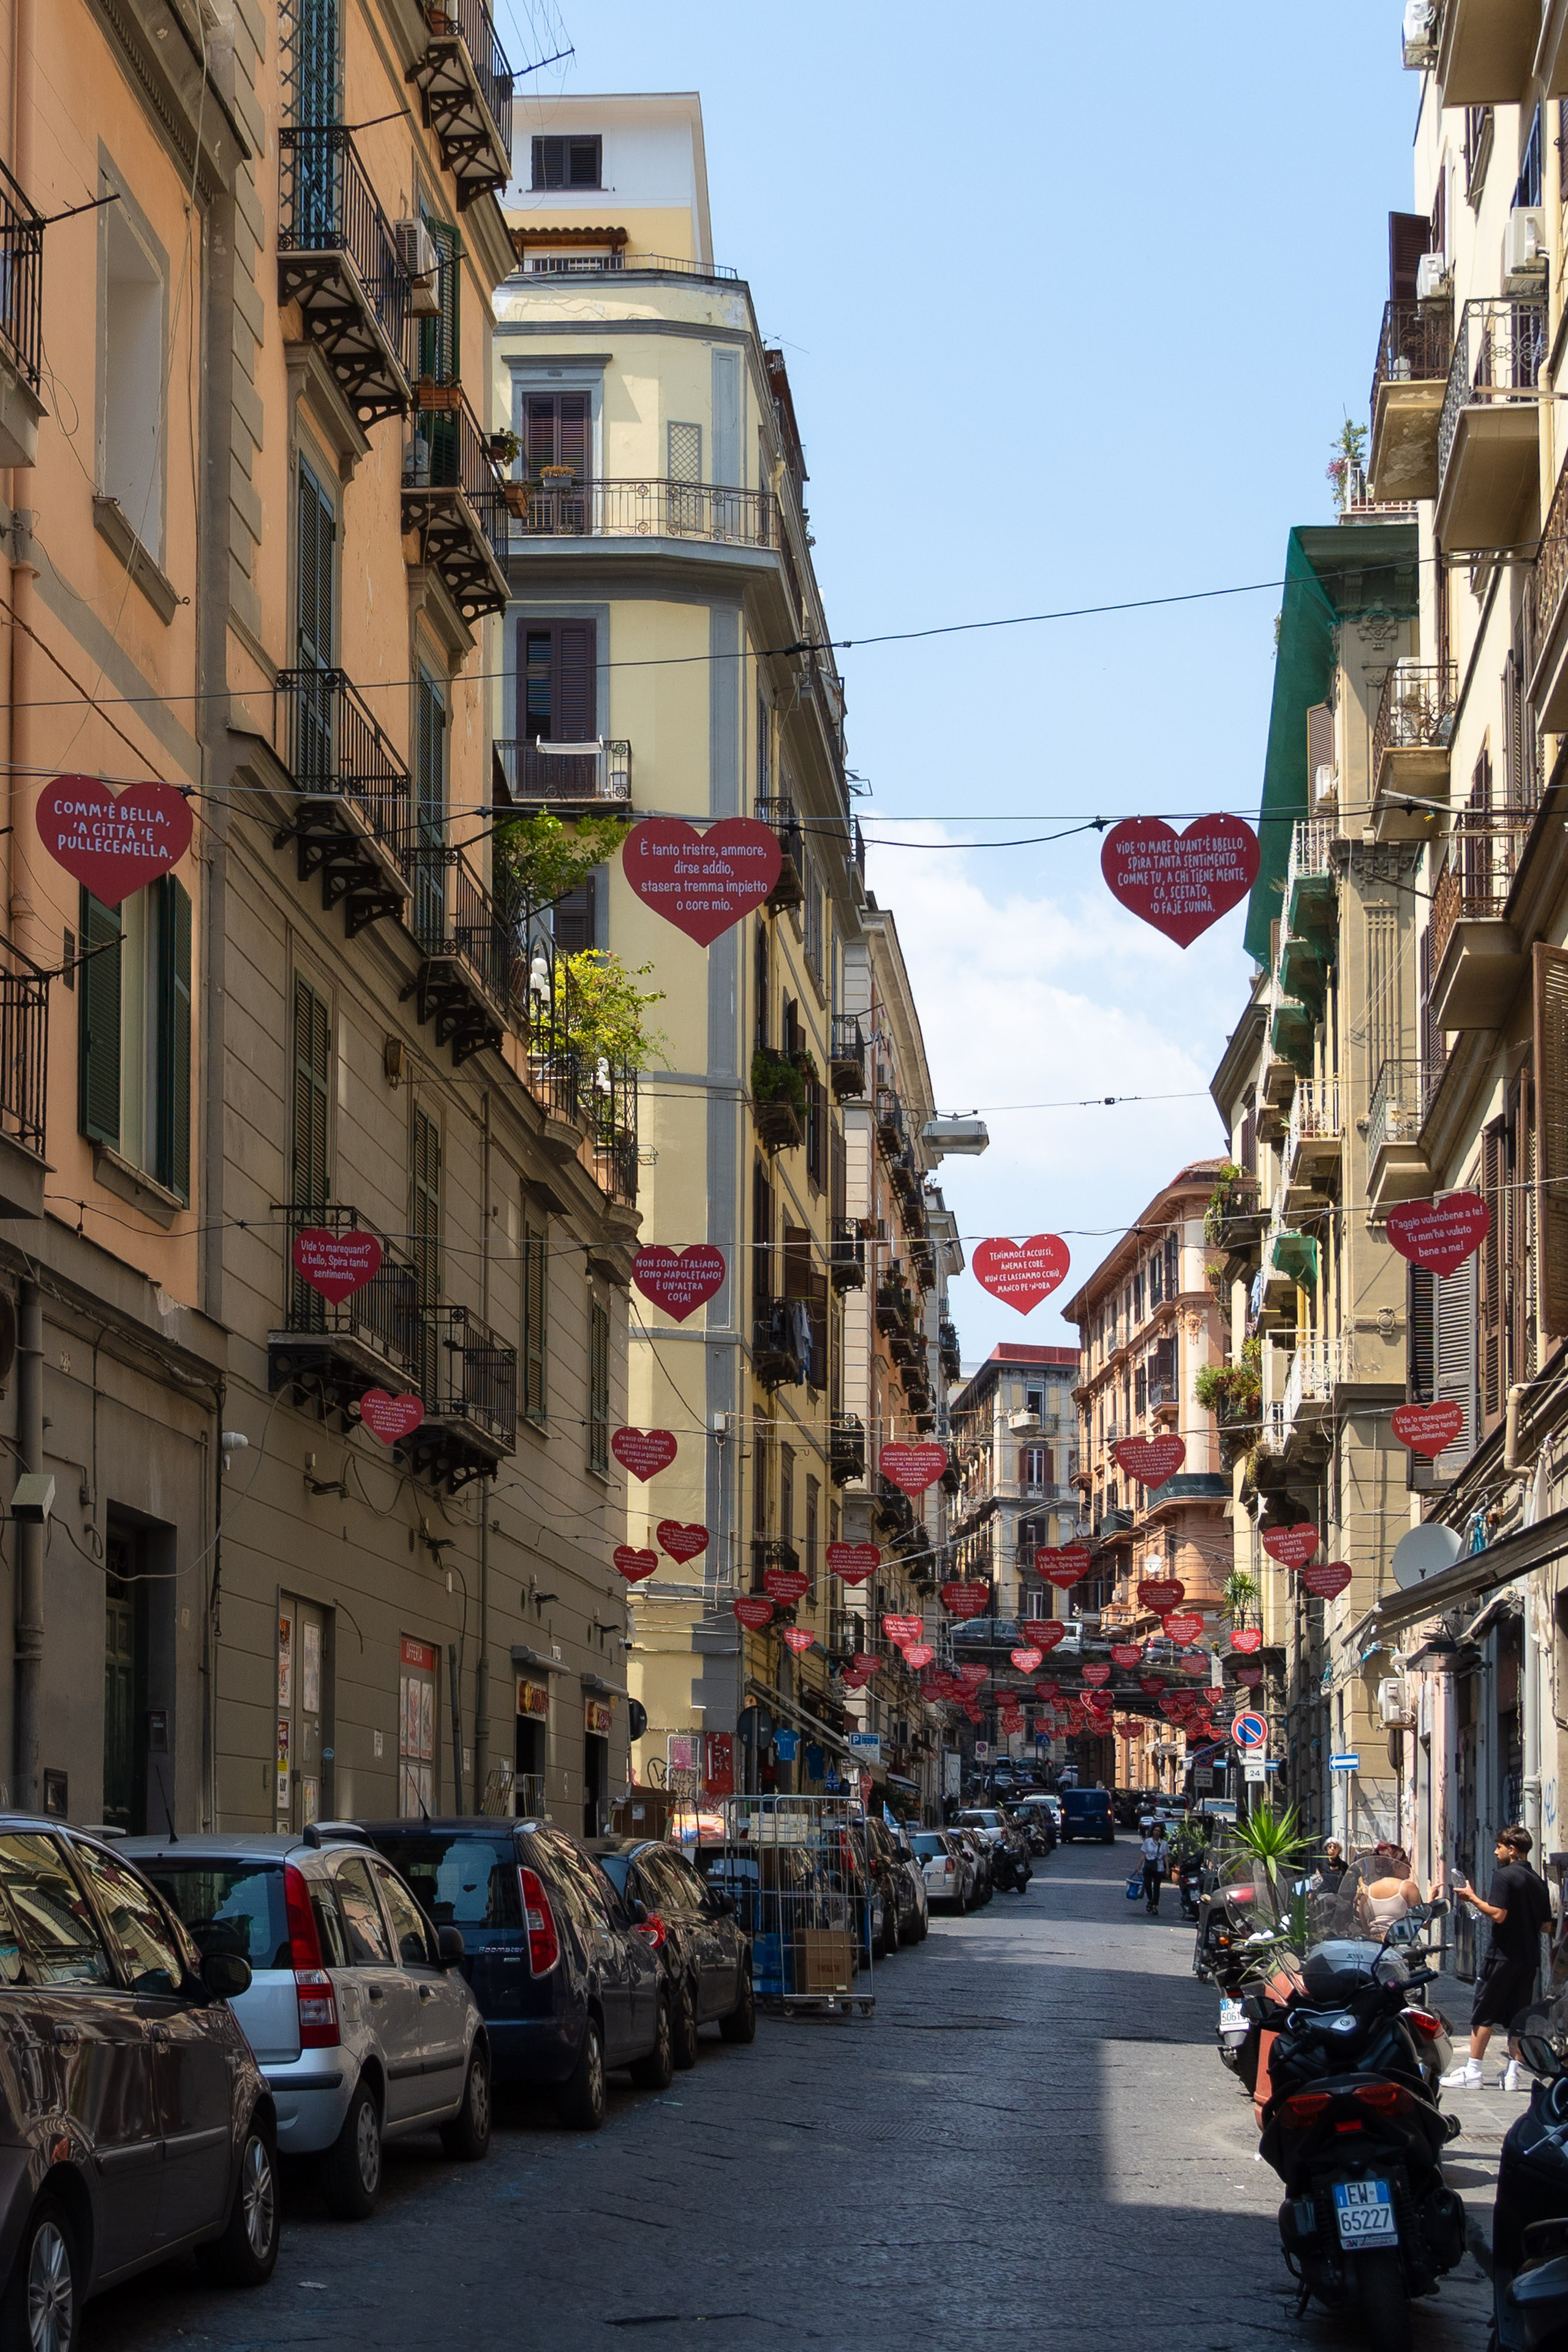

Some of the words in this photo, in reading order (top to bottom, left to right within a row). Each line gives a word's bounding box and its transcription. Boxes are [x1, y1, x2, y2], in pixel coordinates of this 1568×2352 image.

[55, 800, 115, 818] COMM'È
[121, 807, 170, 826] BELLA,
[58, 834, 172, 859] PULLECENELLA.
[641, 839, 649, 855] È
[652, 844, 679, 855] tanto
[682, 843, 718, 858] tristre,
[721, 846, 766, 858] ammore,
[1148, 840, 1171, 853] MARE
[1213, 837, 1246, 852] BBELLO,
[674, 860, 699, 873] dirse
[703, 860, 734, 876] addio,
[1153, 855, 1181, 869] TANTA
[1118, 872, 1148, 886] COMME
[1150, 871, 1164, 886] TU,
[1167, 872, 1172, 882] A
[1216, 867, 1247, 882] MENTE,
[641, 880, 680, 892] stasera
[684, 880, 723, 892] tremma
[726, 880, 767, 897] impietto
[1170, 884, 1210, 899] SCETATO,
[677, 901, 683, 910] o
[686, 901, 709, 910] core
[712, 899, 733, 910] mio.
[1472, 1205, 1483, 1215] te!
[1406, 1233, 1417, 1242] Tu
[1446, 1225, 1471, 1235] vuluto
[301, 1240, 317, 1251] Vide
[1419, 1247, 1439, 1257] bene
[1449, 1240, 1464, 1251] me!
[303, 1254, 306, 1263] è
[308, 1253, 326, 1267] bello,
[328, 1255, 347, 1268] Spira
[350, 1258, 368, 1267] tantu
[314, 1269, 355, 1281] sentimento,
[664, 1270, 721, 1280] NAPOLETANO!
[1008, 1272, 1041, 1281] LASSAMMO
[657, 1280, 660, 1290] È
[663, 1282, 703, 1291] UN'ALTRA
[668, 1292, 690, 1302] COSA!
[1346, 2184, 1368, 2204] EW
[1341, 2207, 1390, 2231] 65227
